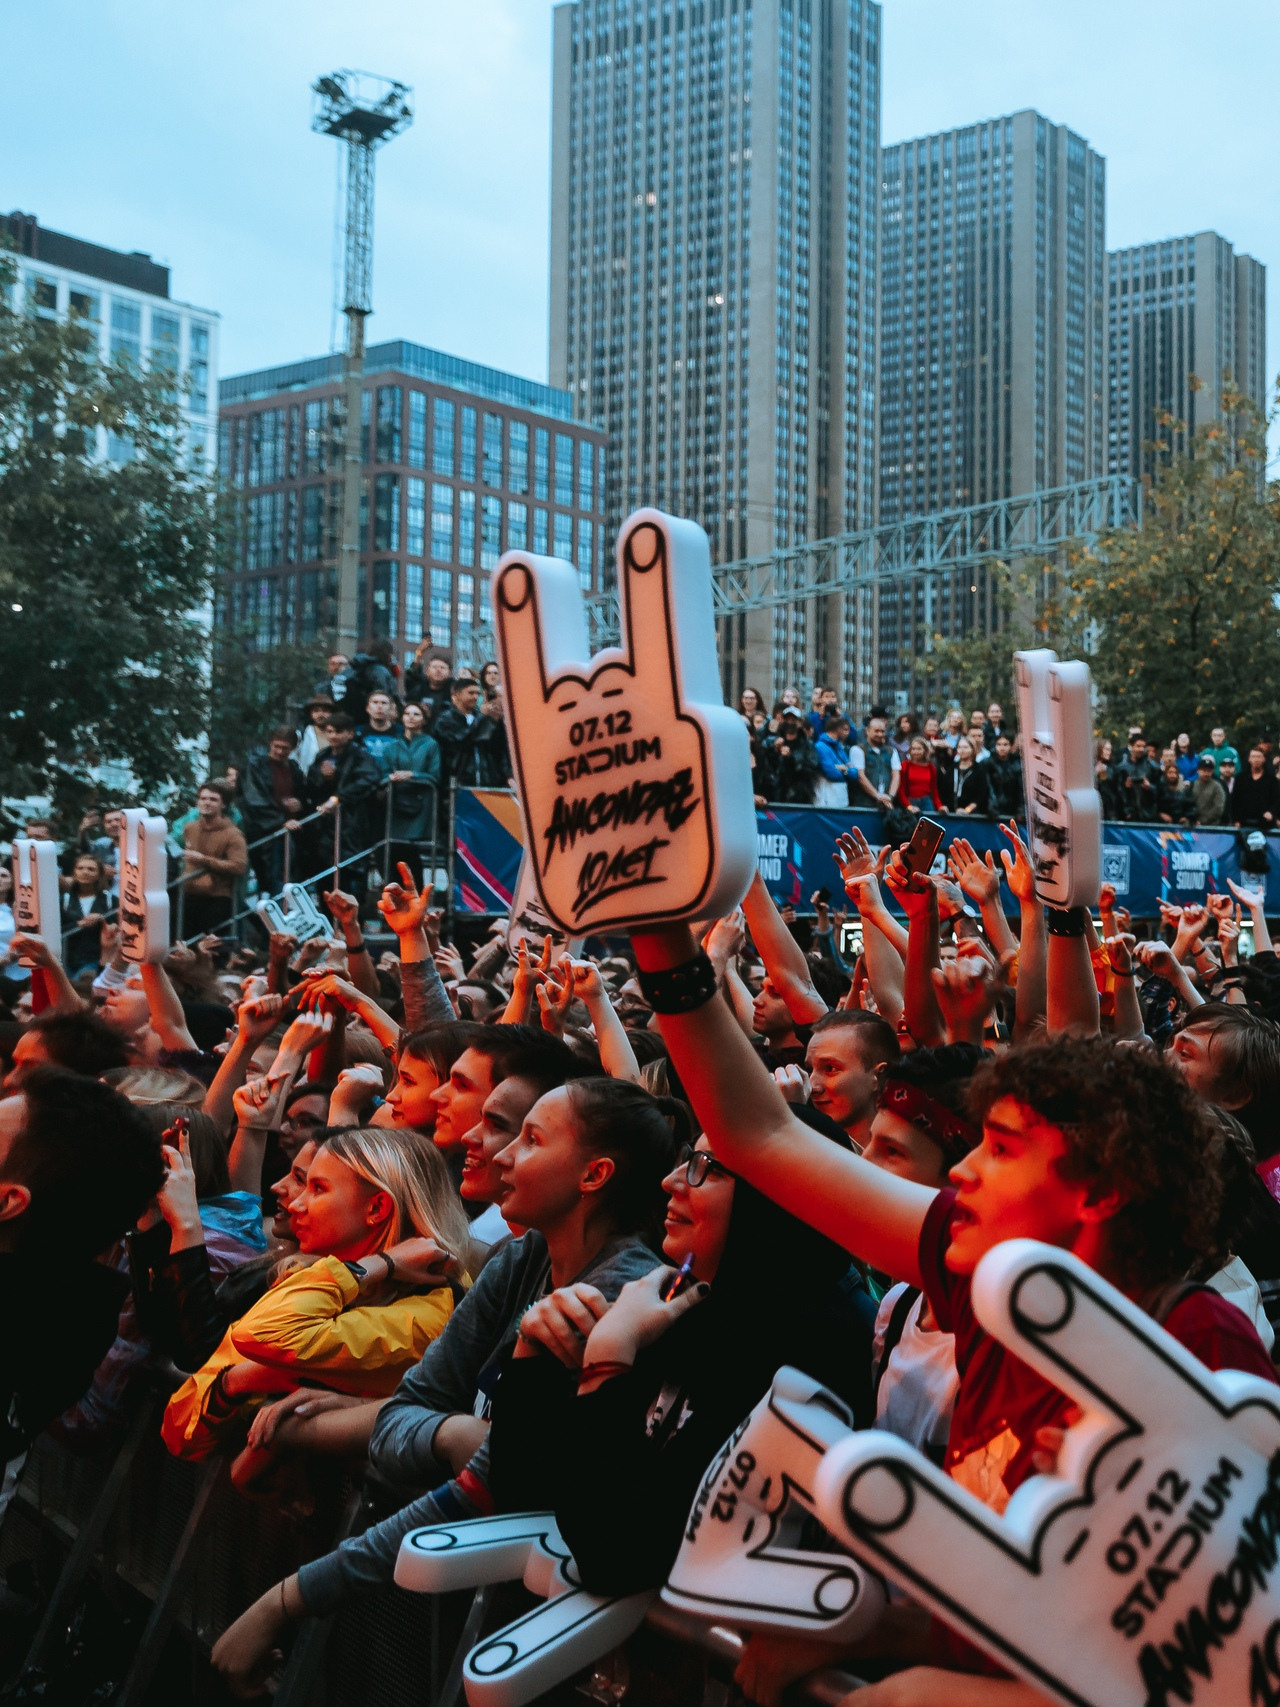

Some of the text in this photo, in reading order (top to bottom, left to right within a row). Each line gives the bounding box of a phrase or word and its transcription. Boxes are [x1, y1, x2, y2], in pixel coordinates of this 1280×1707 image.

[569, 710, 632, 746] 07.12
[555, 736, 662, 785] STADIUM
[1176, 871, 1206, 890] SOUND
[710, 1451, 756, 1522] 07.12
[1106, 1469, 1191, 1574] 07.12
[1111, 1456, 1243, 1639] STADIUM
